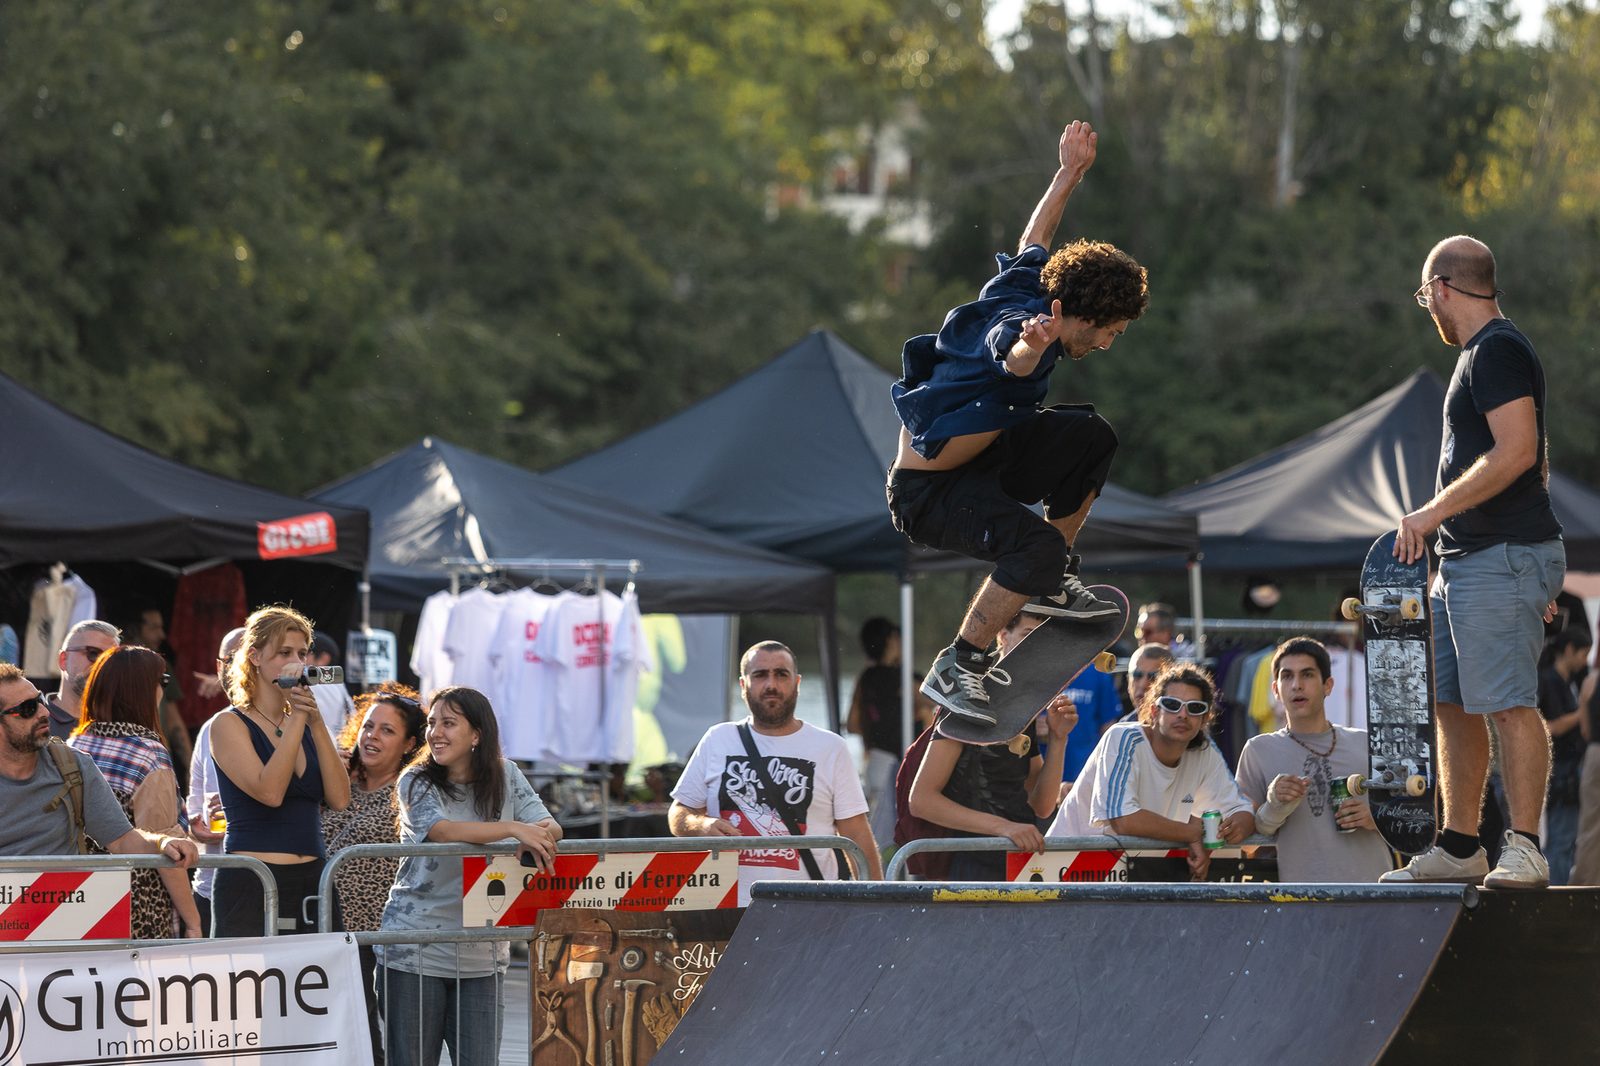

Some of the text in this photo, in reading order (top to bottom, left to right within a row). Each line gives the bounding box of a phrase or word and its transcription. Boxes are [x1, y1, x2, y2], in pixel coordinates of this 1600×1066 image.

[263, 518, 330, 552] GLOBE
[522, 870, 721, 891] Comune di Ferrara
[1058, 866, 1128, 882] Comune
[20, 885, 86, 904] Ferrara
[559, 896, 686, 908] Servizio Infrastrutture
[37, 964, 330, 1032] Giemme
[98, 1029, 259, 1057] Immobiliare
